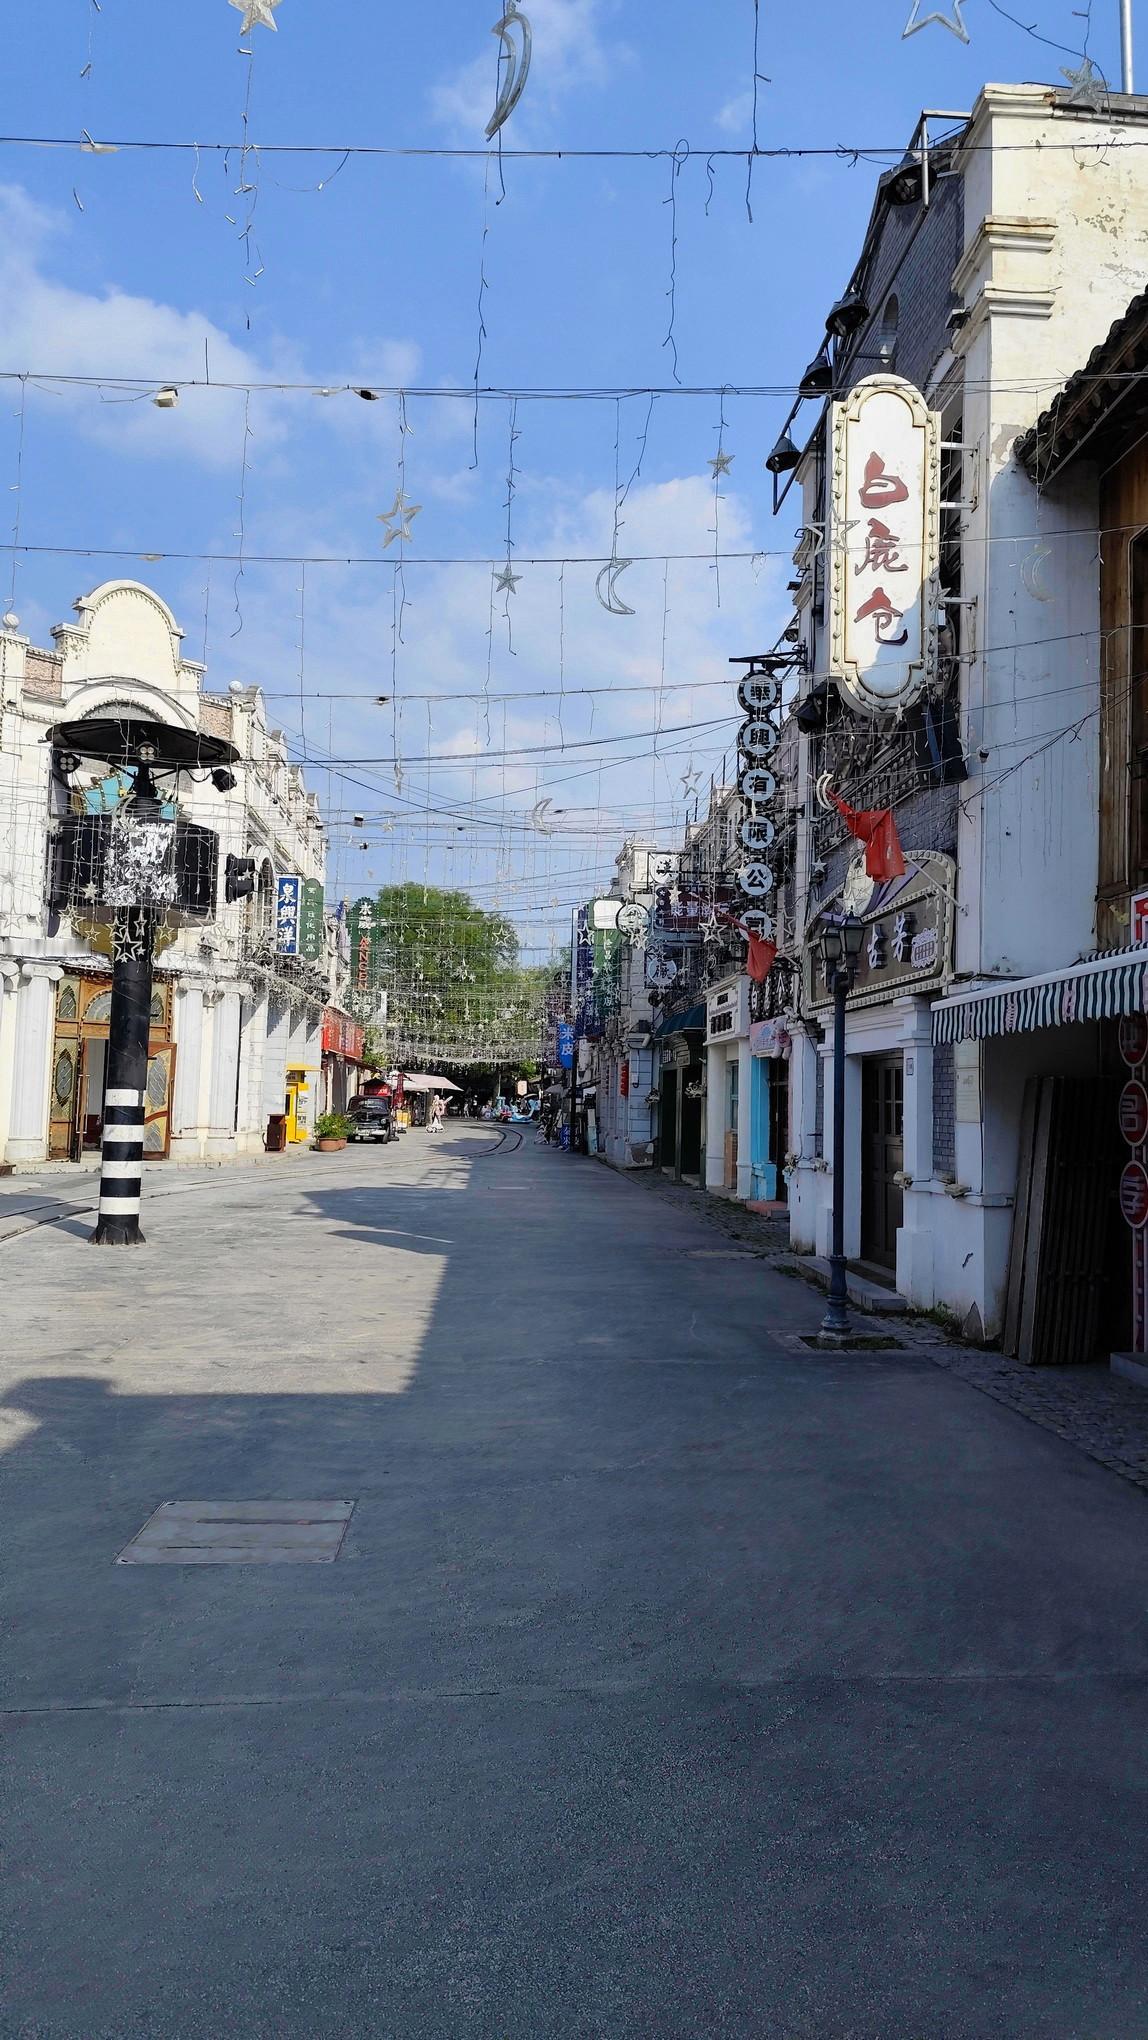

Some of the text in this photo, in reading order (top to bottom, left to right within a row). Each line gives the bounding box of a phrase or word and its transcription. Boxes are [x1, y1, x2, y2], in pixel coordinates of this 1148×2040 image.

[854, 451, 909, 646] 白鹿仓
[560, 1026, 574, 1056] 米皮
